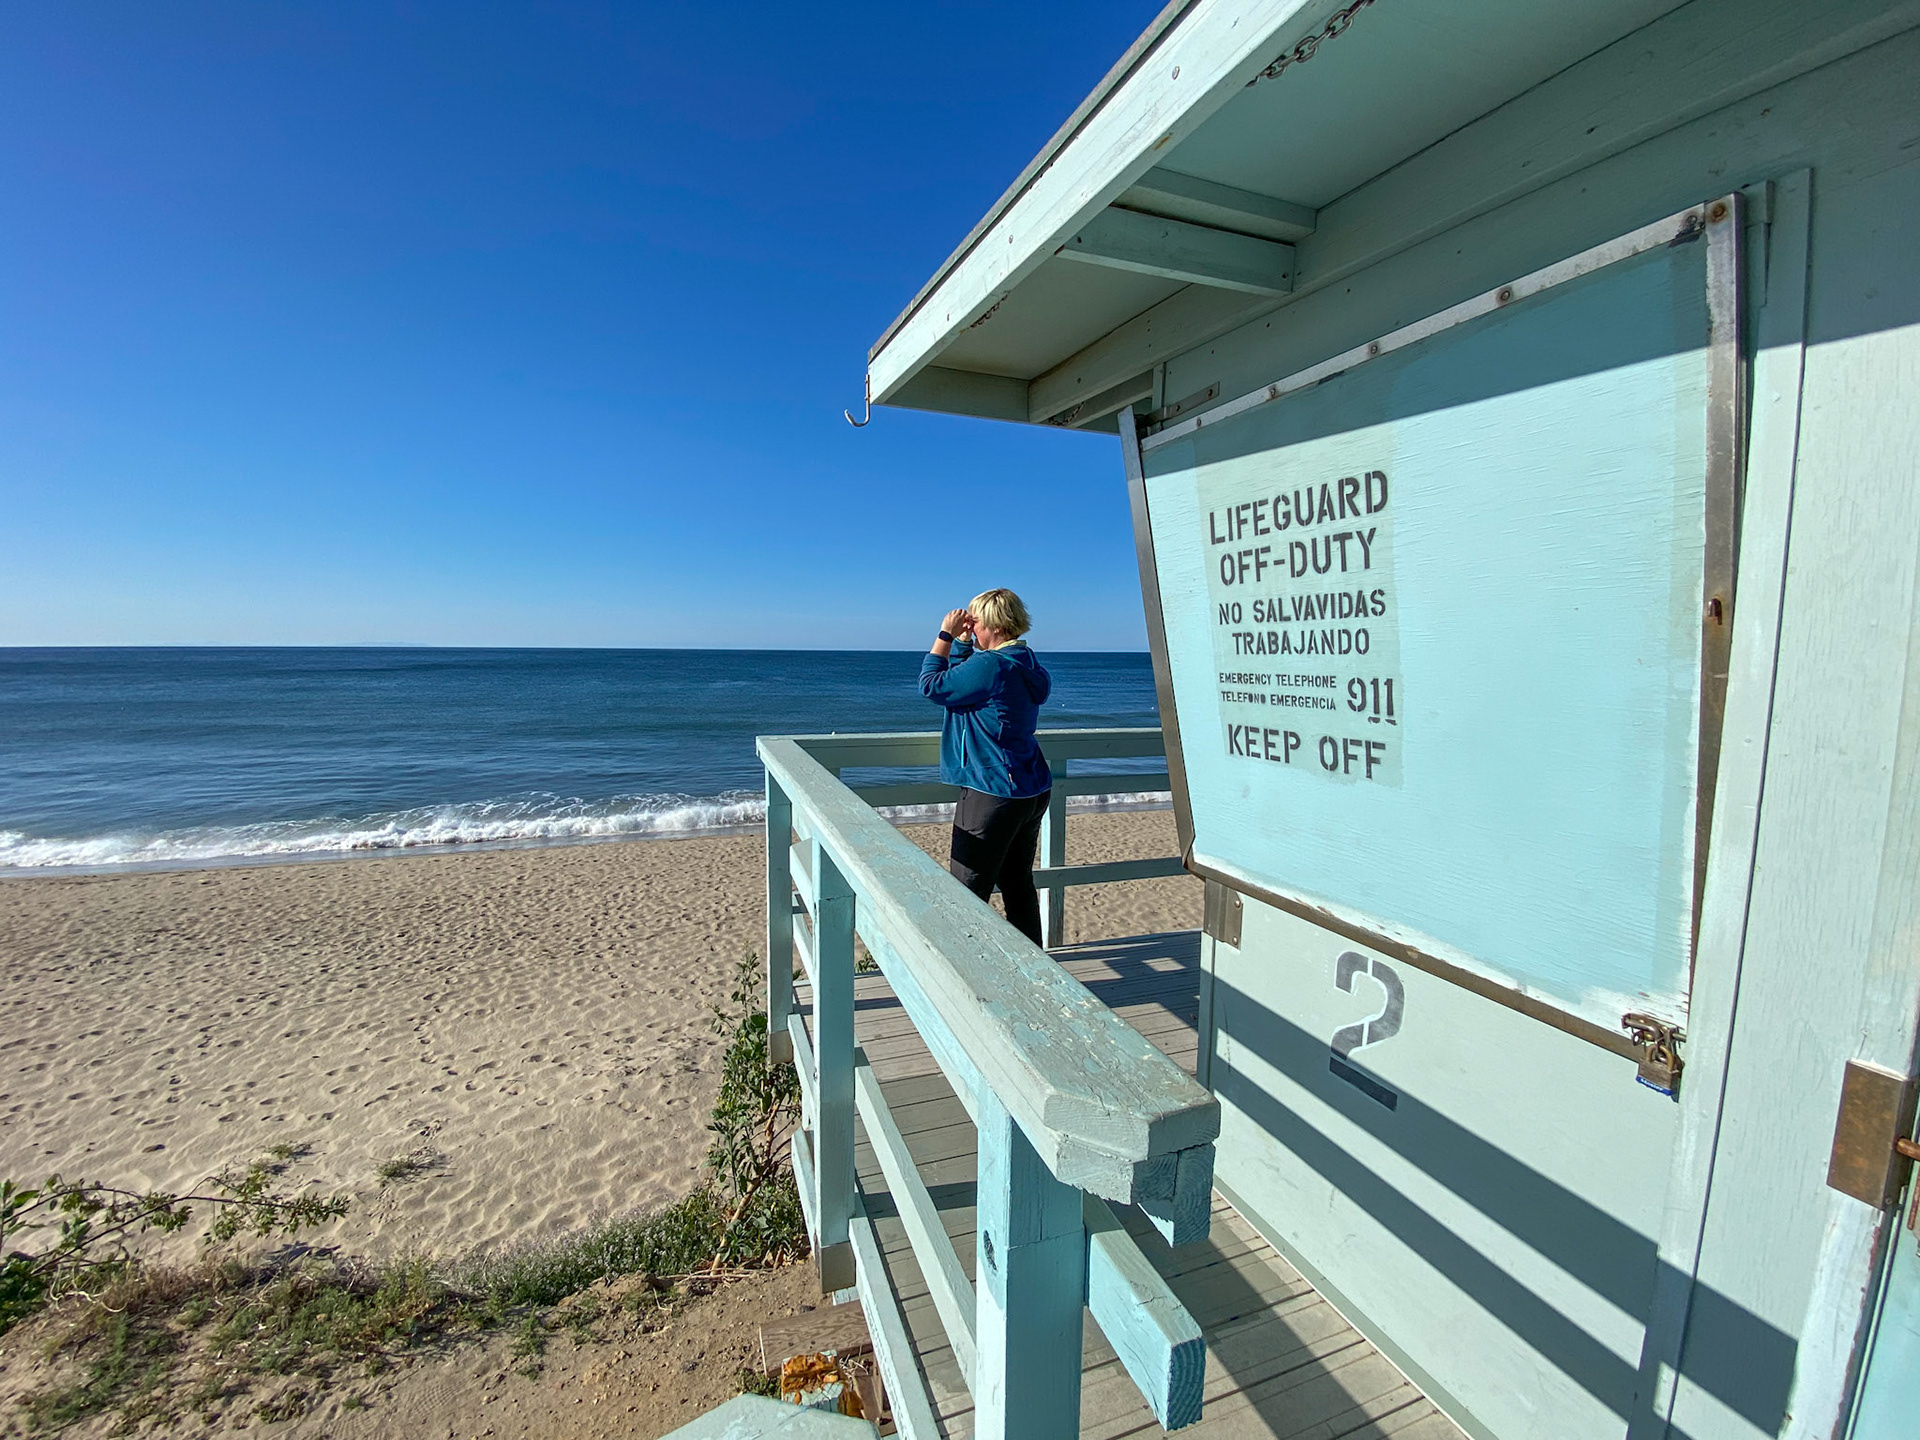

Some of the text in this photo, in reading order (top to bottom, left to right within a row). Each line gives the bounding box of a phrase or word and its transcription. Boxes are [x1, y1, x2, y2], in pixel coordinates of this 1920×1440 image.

[1209, 470, 1388, 545] LIFEGUARD
[1220, 527, 1377, 586] OFF-DUTY
[1219, 589, 1386, 625] NO SALVAVIDAS
[1232, 628, 1370, 655] TRABAJANDO
[1219, 672, 1337, 688] EMERGENCY TELEPHONE
[1347, 677, 1395, 716] 911
[1221, 691, 1337, 711] TELEFONO EMERGENCIA
[1228, 724, 1386, 780] KEEP OFF
[1329, 951, 1405, 1112] 2
